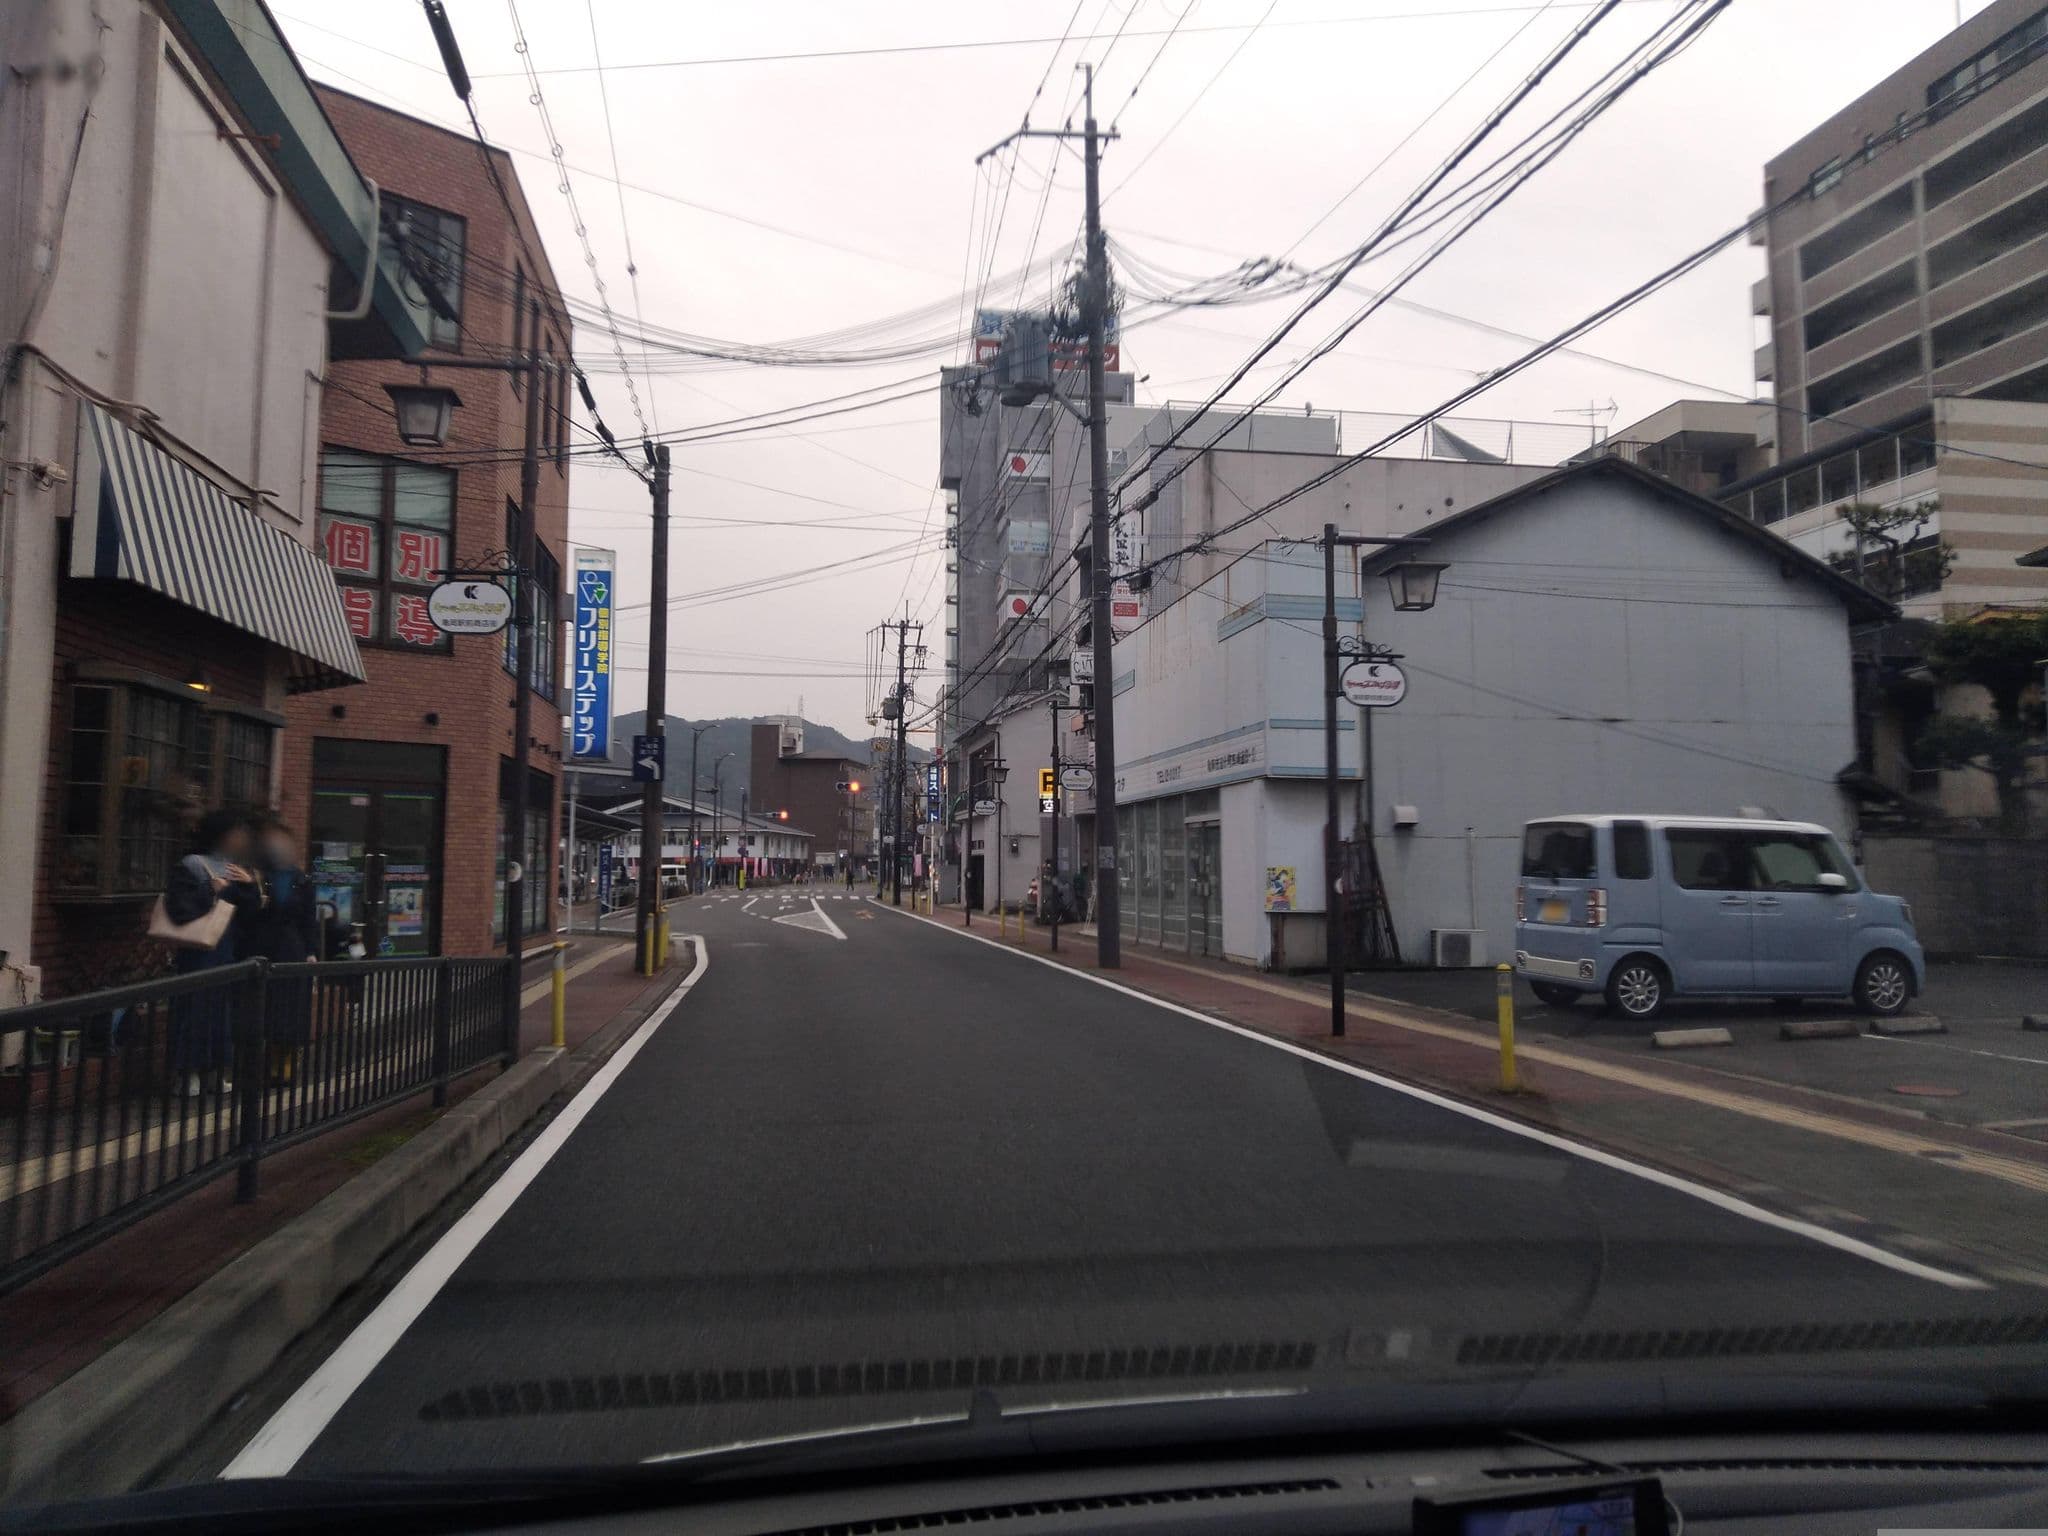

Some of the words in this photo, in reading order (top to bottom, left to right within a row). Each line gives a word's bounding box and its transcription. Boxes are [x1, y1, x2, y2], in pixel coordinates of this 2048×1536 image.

[325, 521, 442, 582] 個別
[574, 607, 597, 755] フリーステップ
